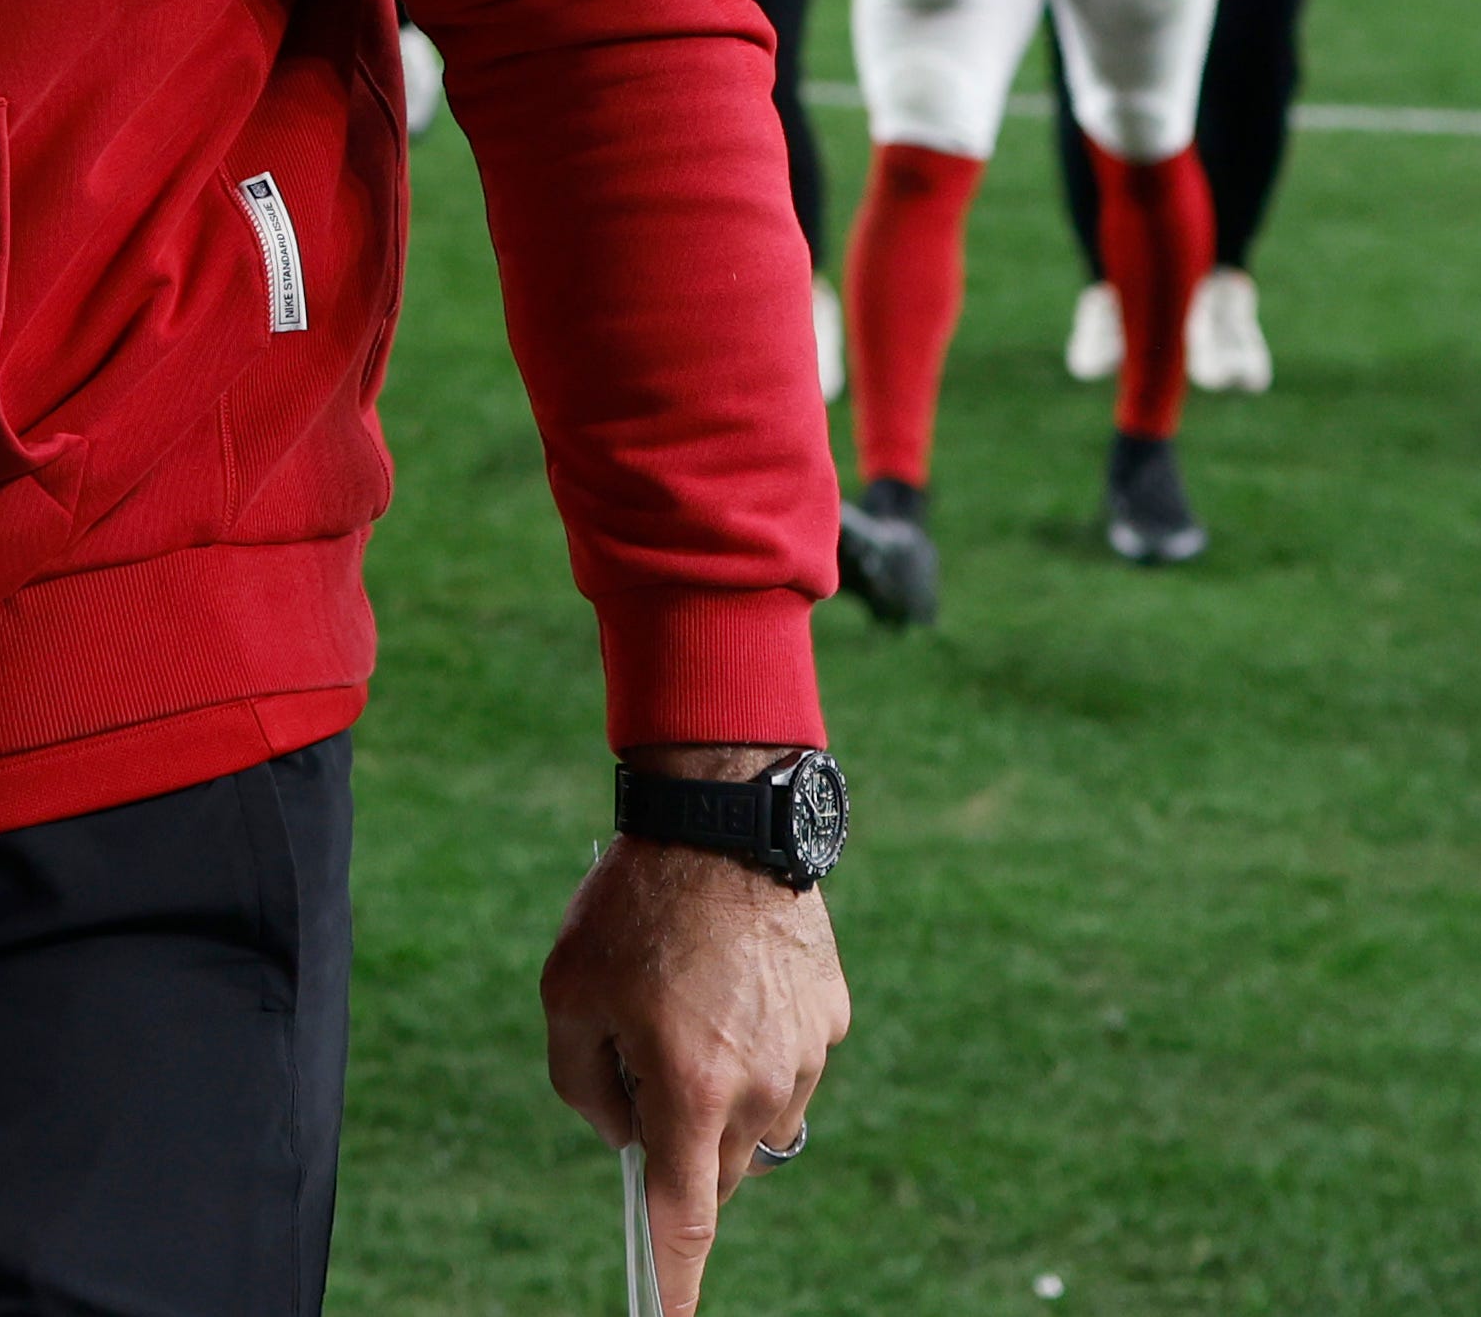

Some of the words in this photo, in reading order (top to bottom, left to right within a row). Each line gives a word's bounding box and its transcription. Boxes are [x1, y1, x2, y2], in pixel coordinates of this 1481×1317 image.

[263, 202, 283, 232] ISSUE
[278, 232, 293, 291] STANDARD
[284, 292, 295, 319] NIKE
